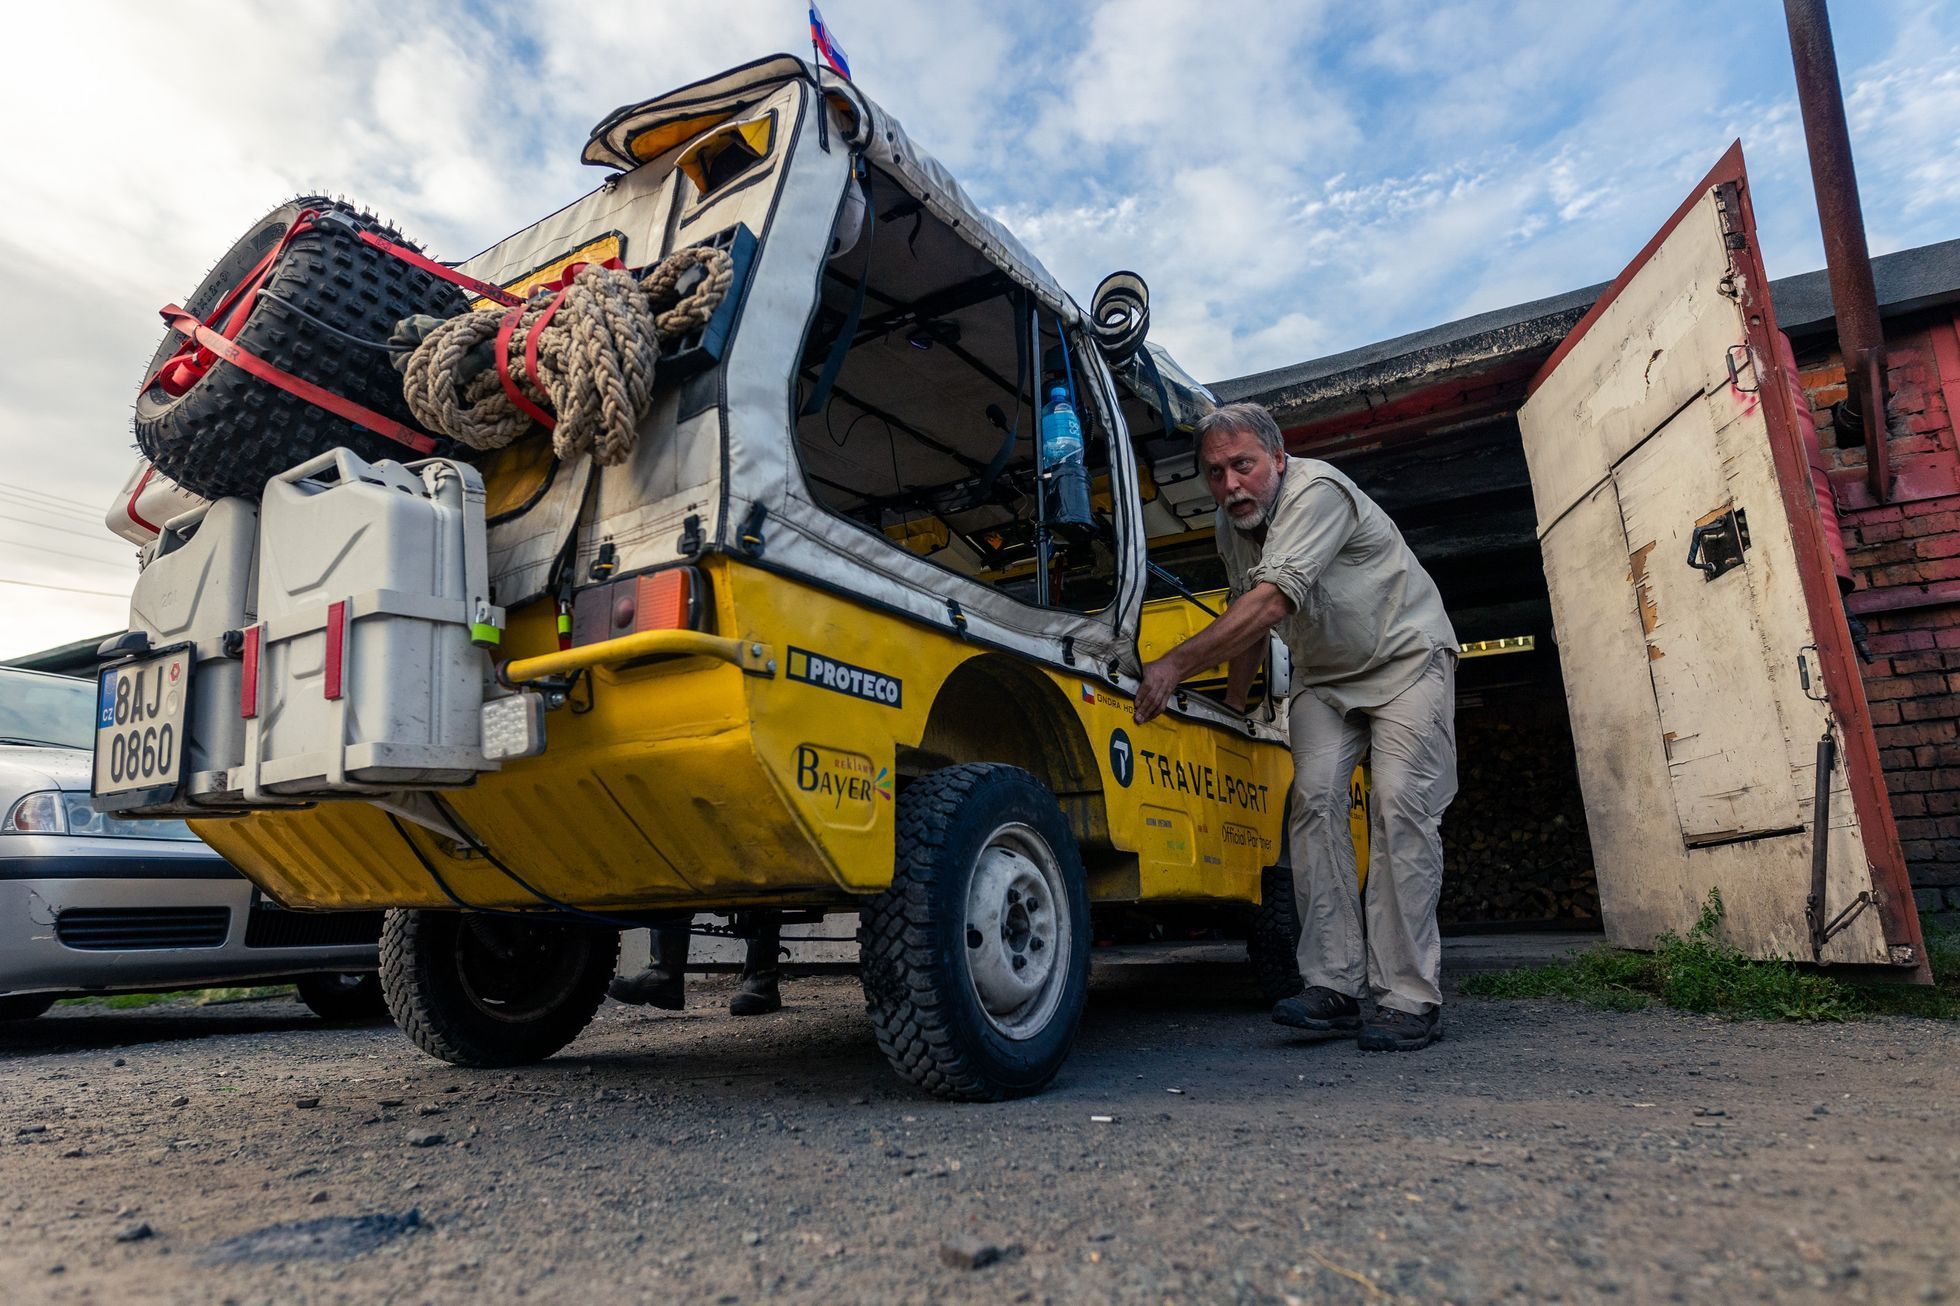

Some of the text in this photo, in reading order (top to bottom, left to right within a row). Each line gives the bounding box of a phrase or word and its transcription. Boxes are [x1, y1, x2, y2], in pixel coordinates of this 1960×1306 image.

[115, 666, 163, 726] 8AJ
[809, 656, 899, 703] PROTECO
[1096, 693, 1121, 710] ONDRA
[102, 706, 114, 722] CZ
[111, 723, 173, 783] 0860
[797, 745, 872, 810] BAYER
[1140, 749, 1269, 814] TRAVELPORT
[1221, 825, 1247, 846] Official
[1247, 830, 1273, 851] Partner
